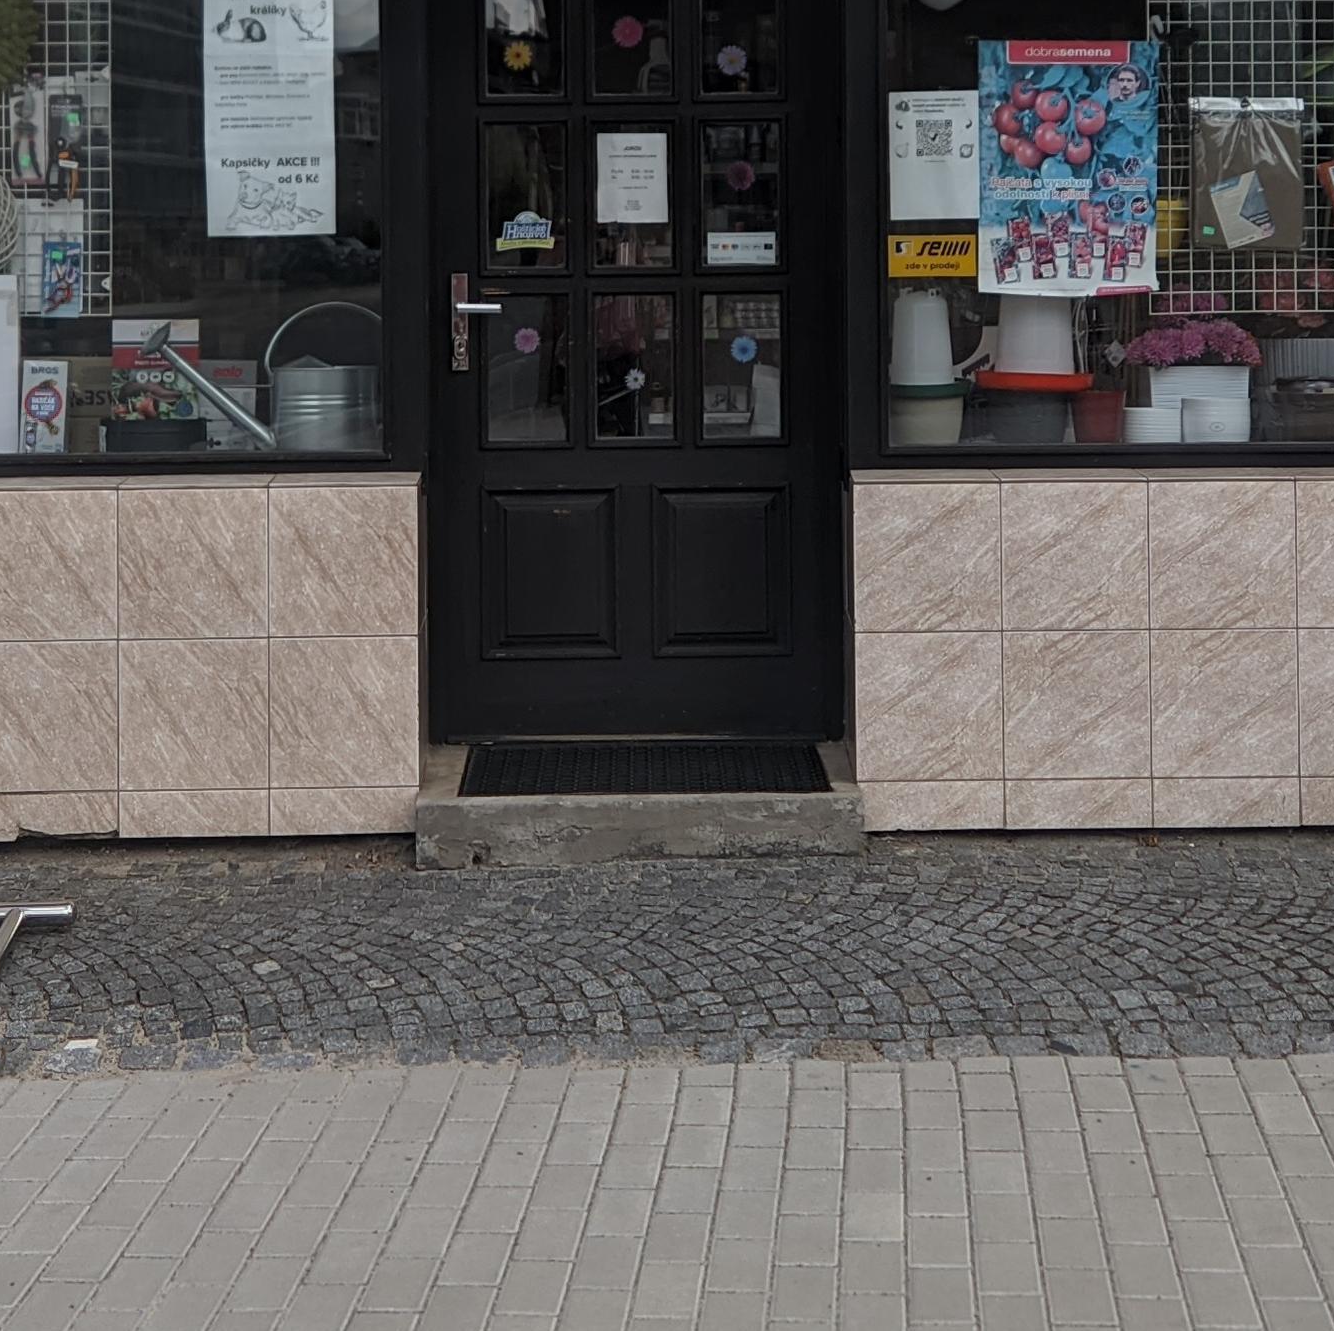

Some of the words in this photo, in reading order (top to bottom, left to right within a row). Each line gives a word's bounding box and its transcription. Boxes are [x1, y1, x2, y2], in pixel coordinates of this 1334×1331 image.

[250, 5, 287, 16] králíky
[1024, 46, 1112, 58] dobrasemena
[221, 157, 271, 169] Kapsičky
[277, 156, 307, 166] AKCE
[278, 174, 292, 184] od
[295, 174, 302, 183] 6
[306, 173, 319, 183] Kč
[1044, 178, 1092, 190] vysokou
[905, 262, 922, 270] zde
[930, 261, 960, 272] prodeji
